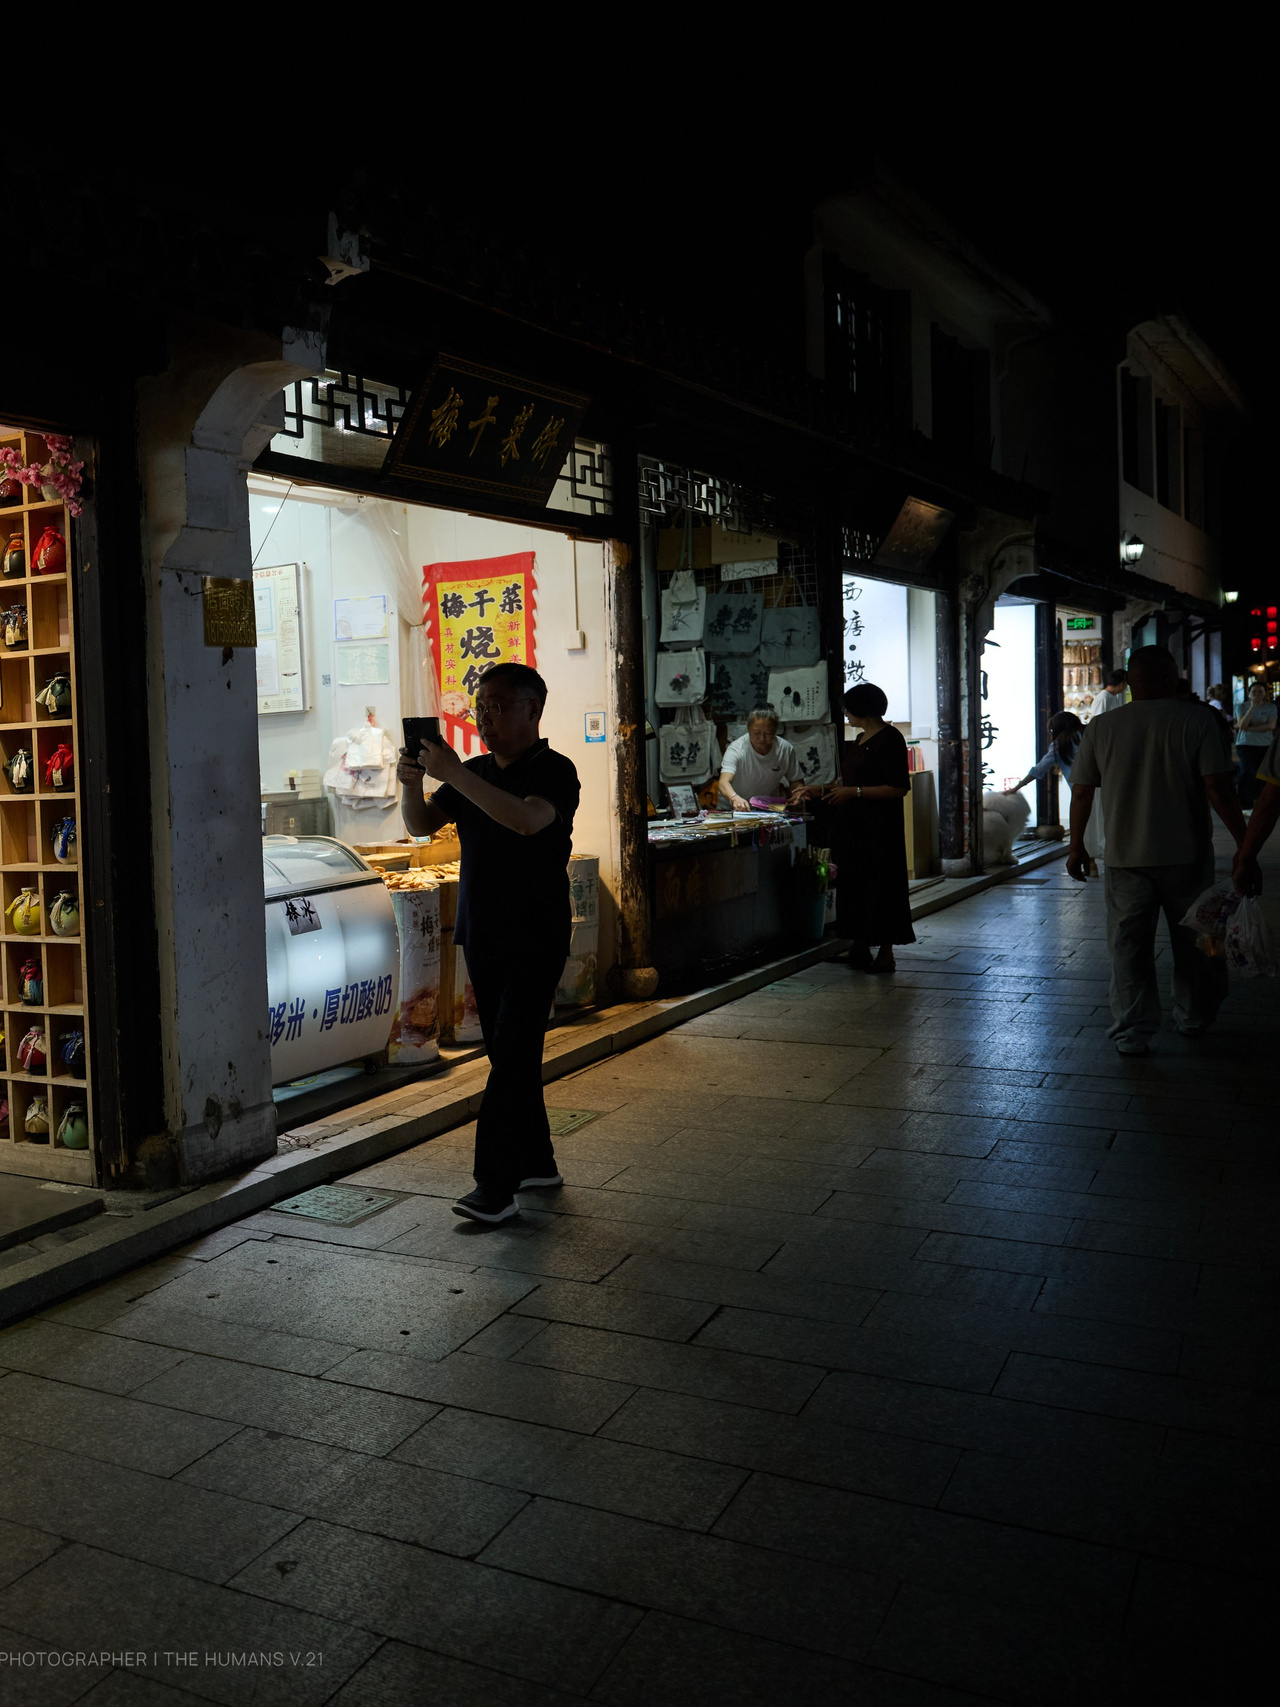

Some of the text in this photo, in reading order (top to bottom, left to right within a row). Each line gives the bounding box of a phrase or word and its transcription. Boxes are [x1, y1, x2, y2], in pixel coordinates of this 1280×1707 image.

[441, 583, 523, 619] 梅干菜
[444, 627, 457, 686] 真材实料
